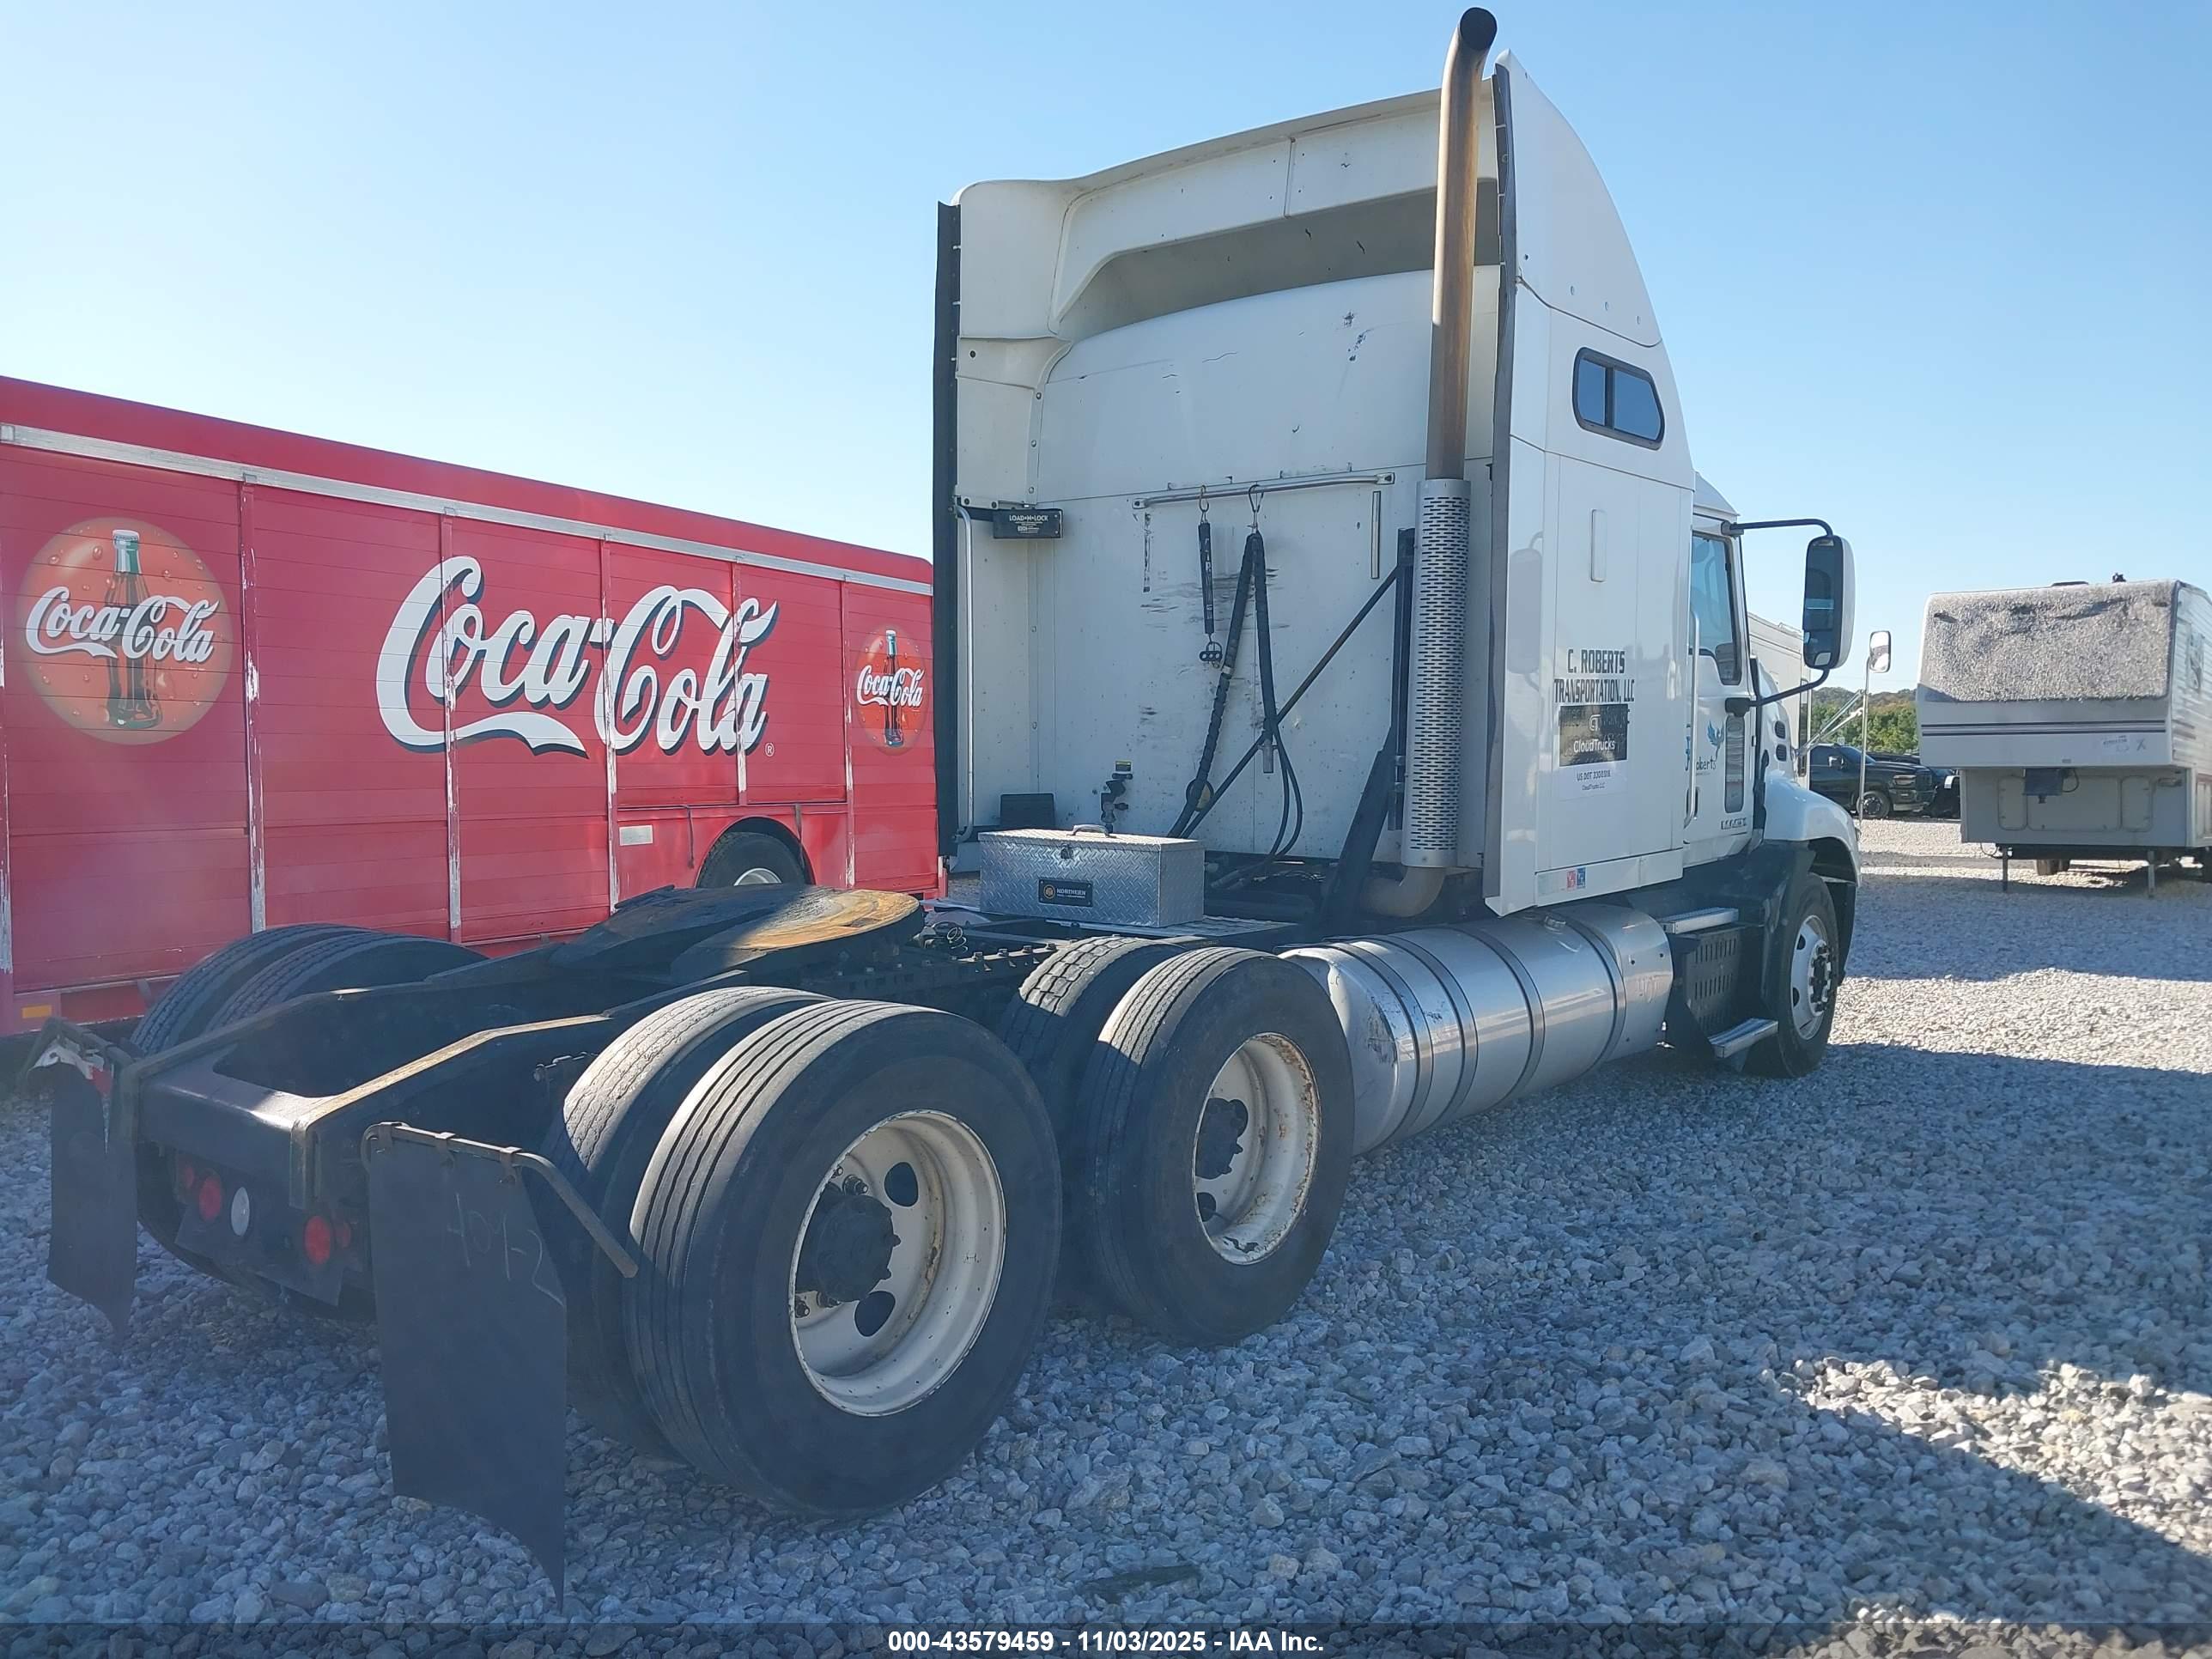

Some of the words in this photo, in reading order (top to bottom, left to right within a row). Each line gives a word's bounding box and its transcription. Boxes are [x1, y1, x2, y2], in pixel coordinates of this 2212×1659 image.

[26, 586, 219, 663] Coca-Cola
[376, 556, 778, 759] Coca-Cola
[1567, 648, 1577, 674] C.
[1581, 648, 1626, 674] ROBERTS
[857, 665, 925, 707] Coca-Cola
[1623, 678, 1635, 702] LLC
[1573, 738, 1615, 753] CloudTrucks
[1056, 888, 1086, 896] NORTHERN
